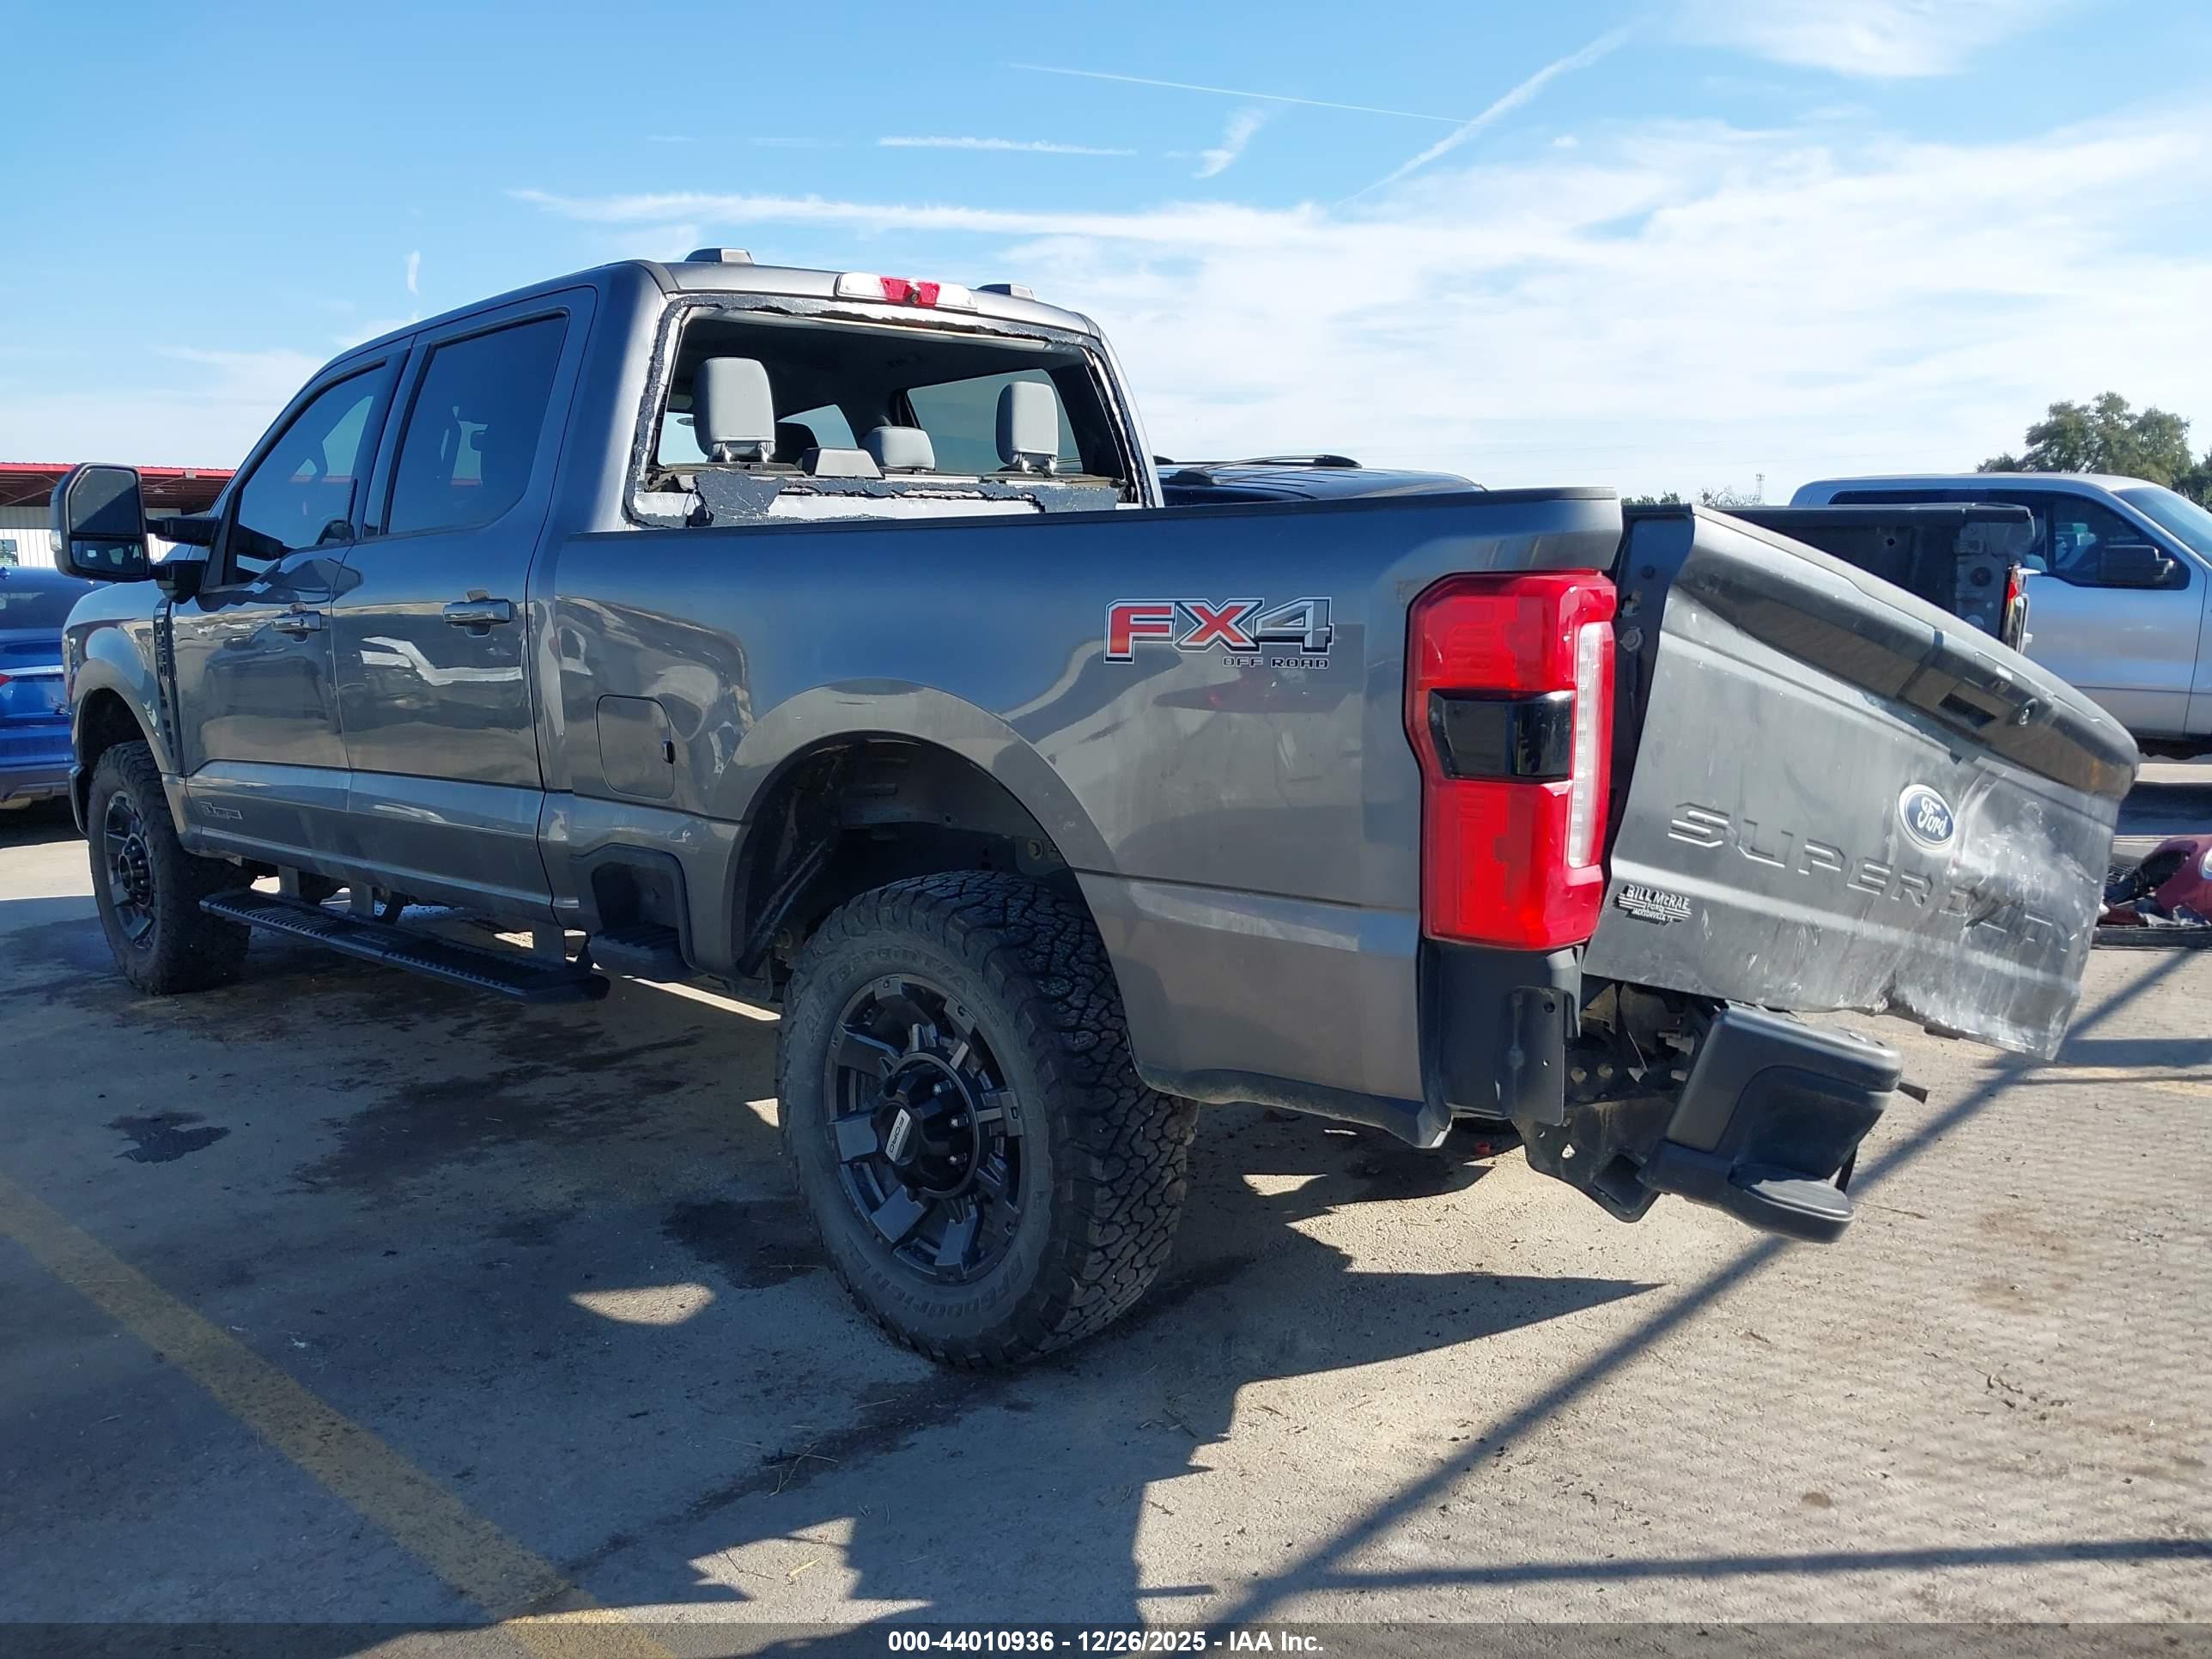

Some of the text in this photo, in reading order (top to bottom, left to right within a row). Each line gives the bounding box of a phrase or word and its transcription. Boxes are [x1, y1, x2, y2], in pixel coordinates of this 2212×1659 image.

[1103, 598, 1334, 665] FX4
[1222, 656, 1330, 670] OFF ROAD
[1917, 796, 1949, 838] Ford
[1667, 801, 1933, 908] SUPER
[1626, 884, 1691, 911] BILL McRAE
[889, 1116, 905, 1153] FORD
